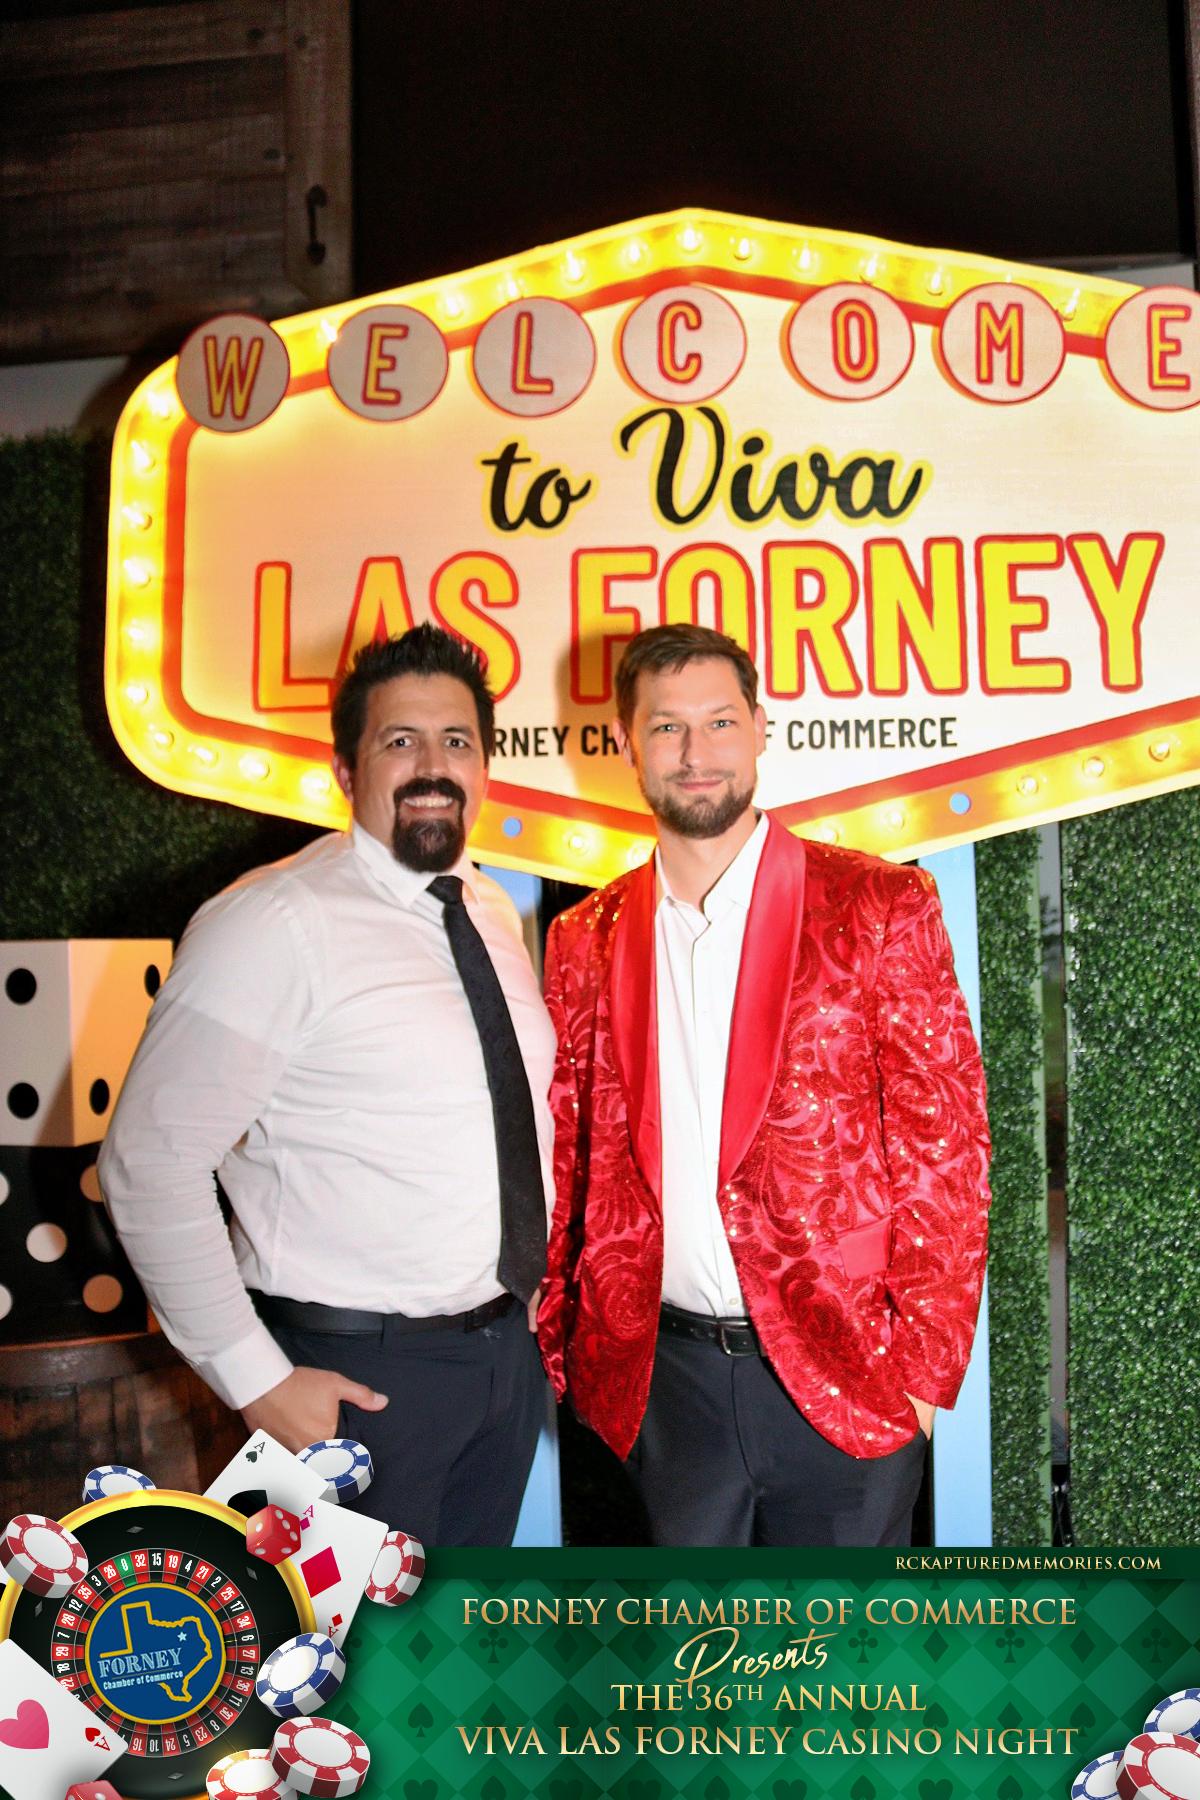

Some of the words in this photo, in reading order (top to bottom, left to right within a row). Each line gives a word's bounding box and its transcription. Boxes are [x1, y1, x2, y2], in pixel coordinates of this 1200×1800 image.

[481, 442, 592, 532] to
[620, 405, 924, 526] Viva
[252, 550, 521, 714] LAS
[570, 532, 1166, 706] FORNEY
[493, 725, 568, 757] RNEY
[787, 716, 959, 751] COMMERCE
